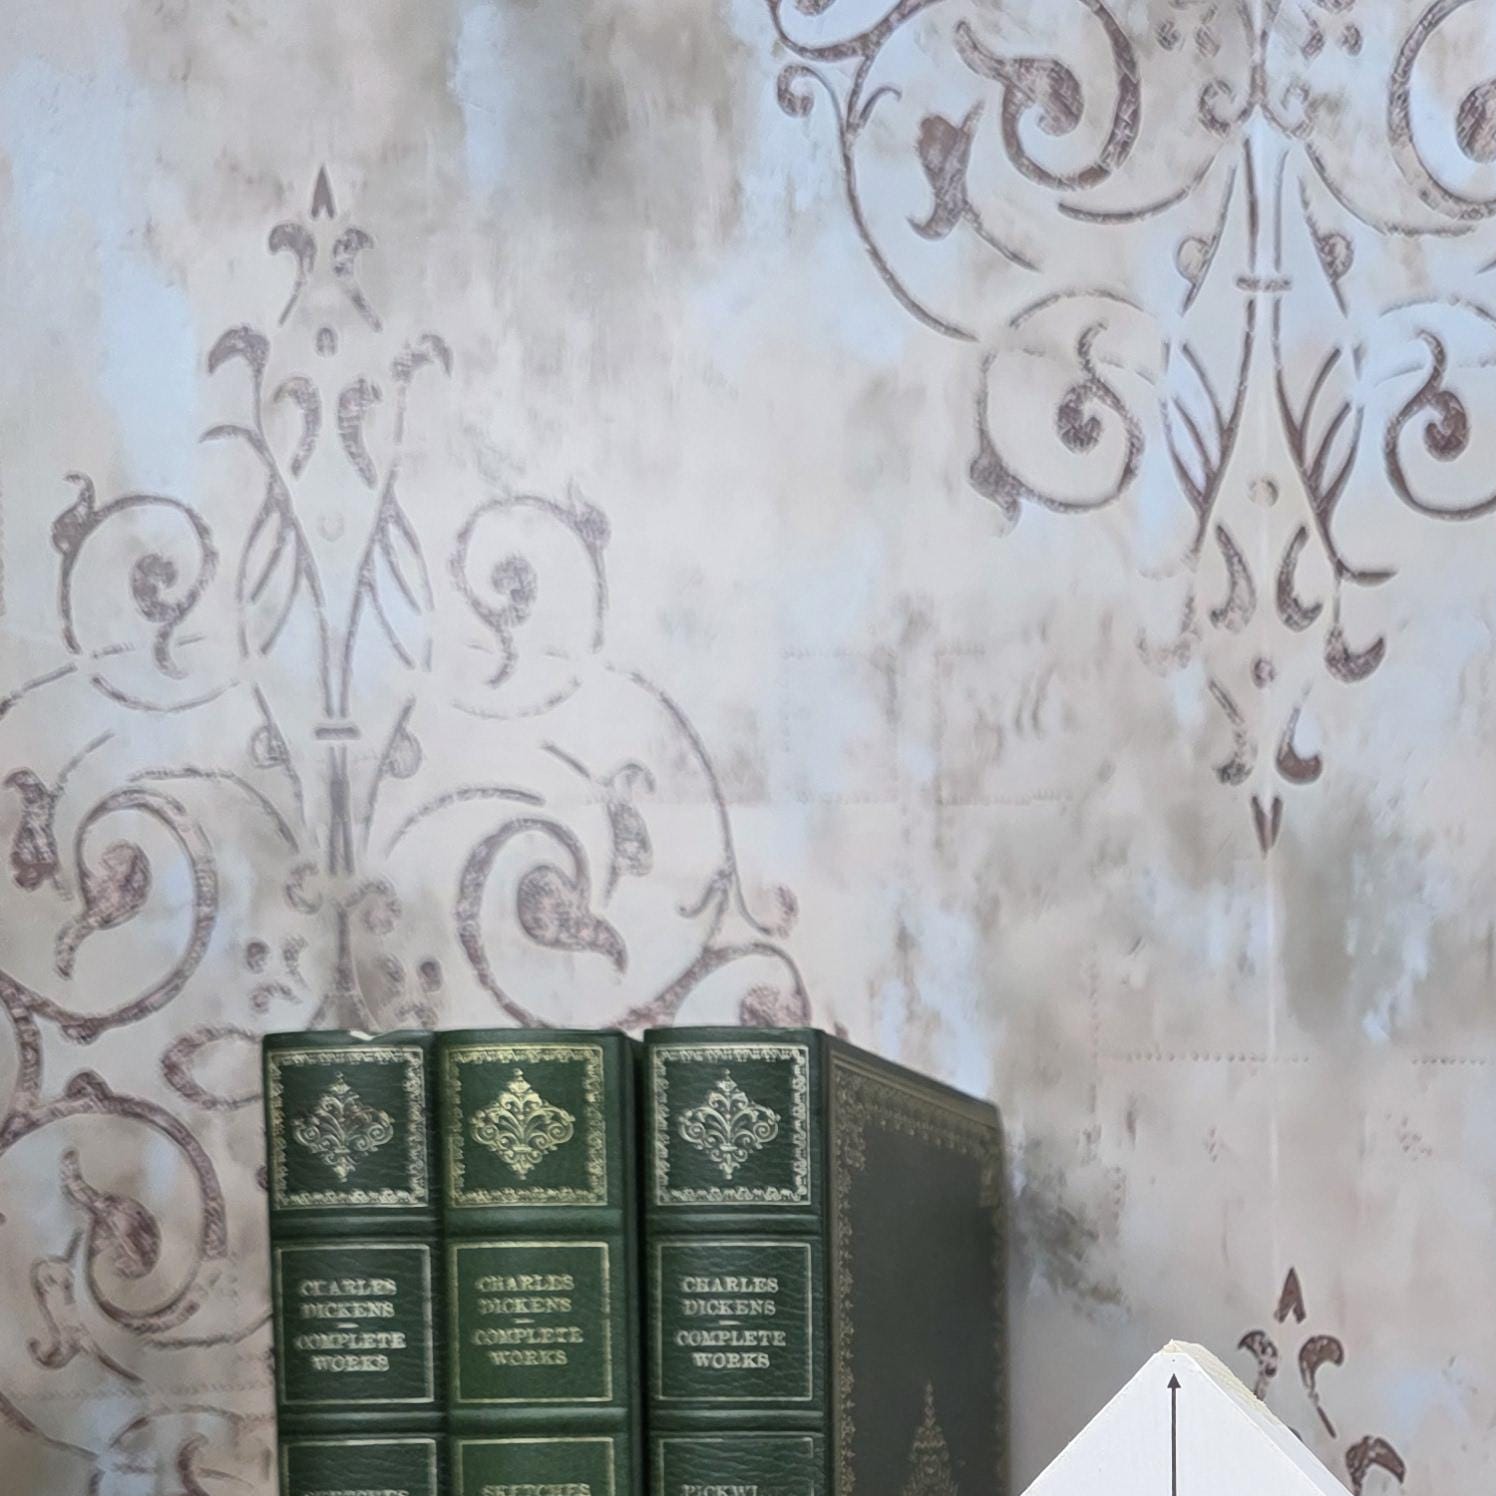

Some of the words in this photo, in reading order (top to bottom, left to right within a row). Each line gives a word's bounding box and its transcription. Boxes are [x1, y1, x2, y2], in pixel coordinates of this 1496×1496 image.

[299, 1278, 397, 1296] CHARLES
[475, 1274, 574, 1292] CHARLES
[681, 1276, 778, 1294] CHARLES
[301, 1300, 394, 1318] DICKENS
[480, 1296, 572, 1313] DICKENS
[683, 1298, 775, 1316] DICKENS
[295, 1332, 406, 1350] COMPLETE
[472, 1327, 583, 1345] COMPLETE
[674, 1329, 786, 1346] COMPLETE
[312, 1354, 390, 1371] WORKS
[489, 1349, 568, 1367] WORKS
[692, 1352, 770, 1369] WORKS
